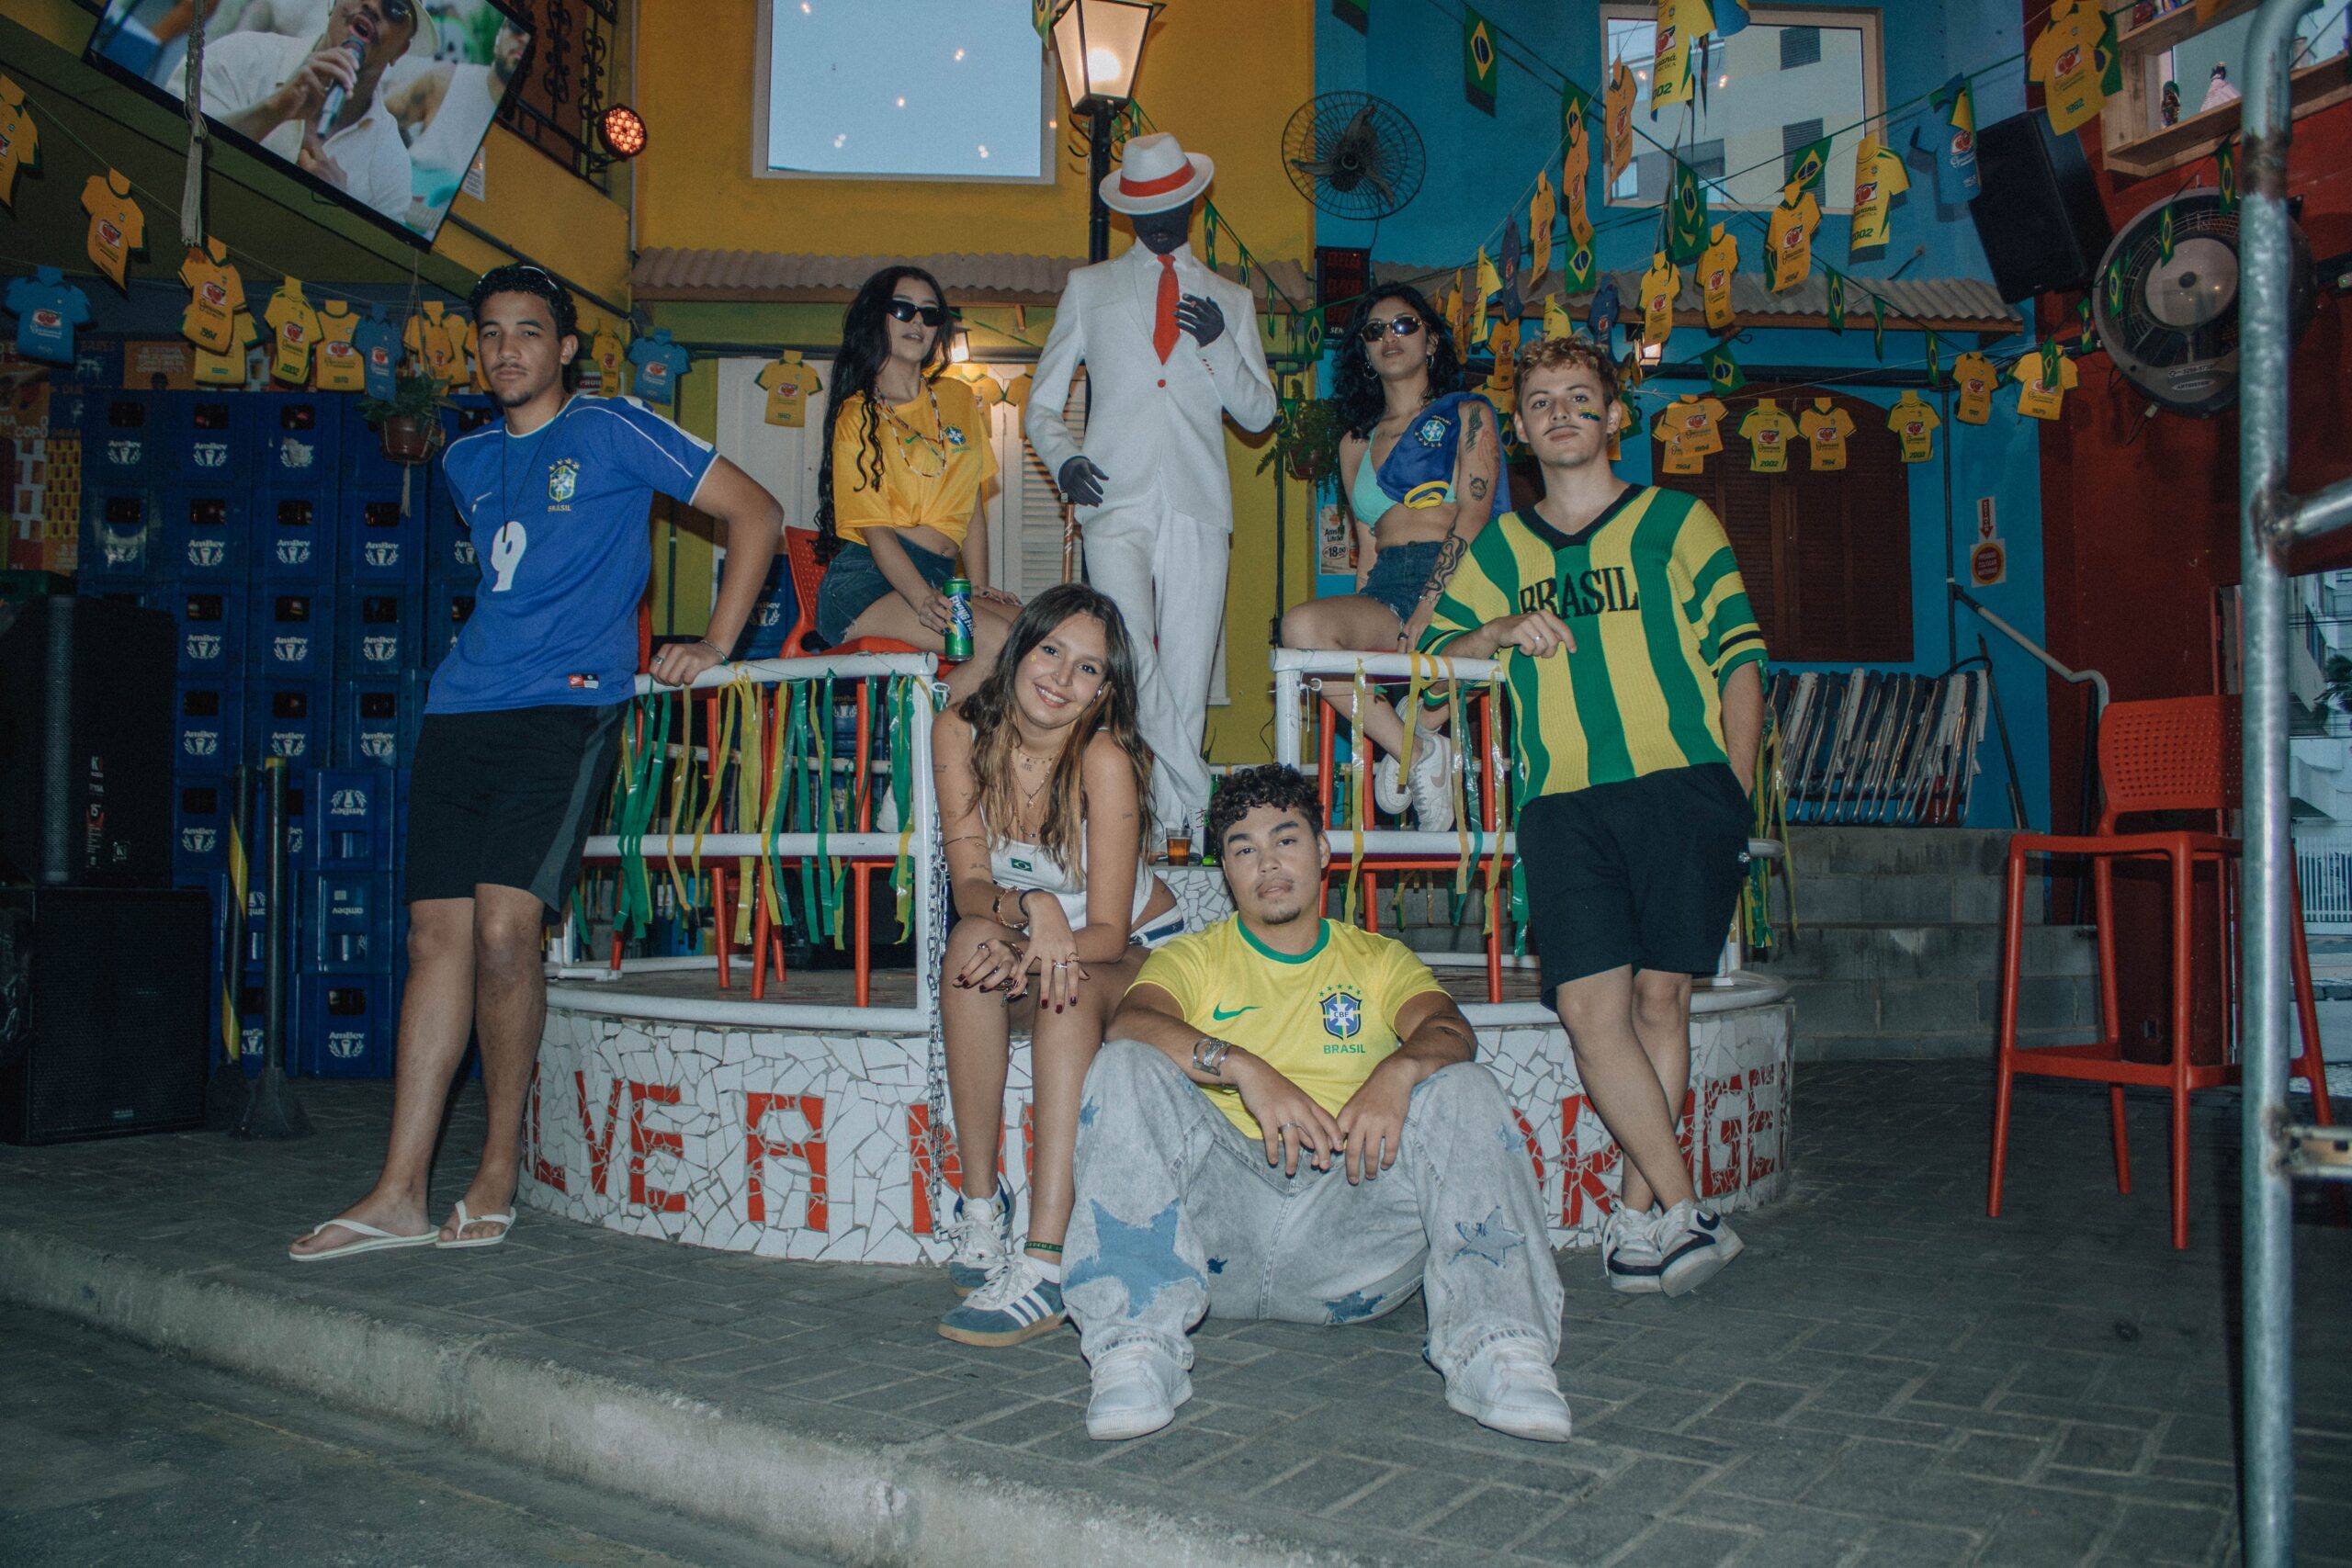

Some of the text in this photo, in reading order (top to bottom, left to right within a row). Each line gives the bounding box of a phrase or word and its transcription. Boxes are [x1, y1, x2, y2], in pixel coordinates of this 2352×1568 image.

[193, 442, 228, 450] AmBev
[547, 504, 571, 513] BRASIL
[188, 539, 225, 547] AmBev
[277, 539, 311, 547] AmBev
[365, 541, 399, 549] AmBev
[491, 521, 527, 592] 9
[1520, 567, 1639, 620] BRASIL
[187, 634, 221, 642] AmBev
[184, 730, 219, 739] AmBev
[271, 732, 306, 740] AmBev
[360, 732, 395, 740] AmBev
[331, 807, 367, 816] AmBev
[182, 827, 218, 835] AmBev
[328, 1032, 365, 1040] AmBev
[1323, 1043, 1366, 1055] BRASIL
[521, 1061, 686, 1213] LVE
[745, 1092, 827, 1232] A
